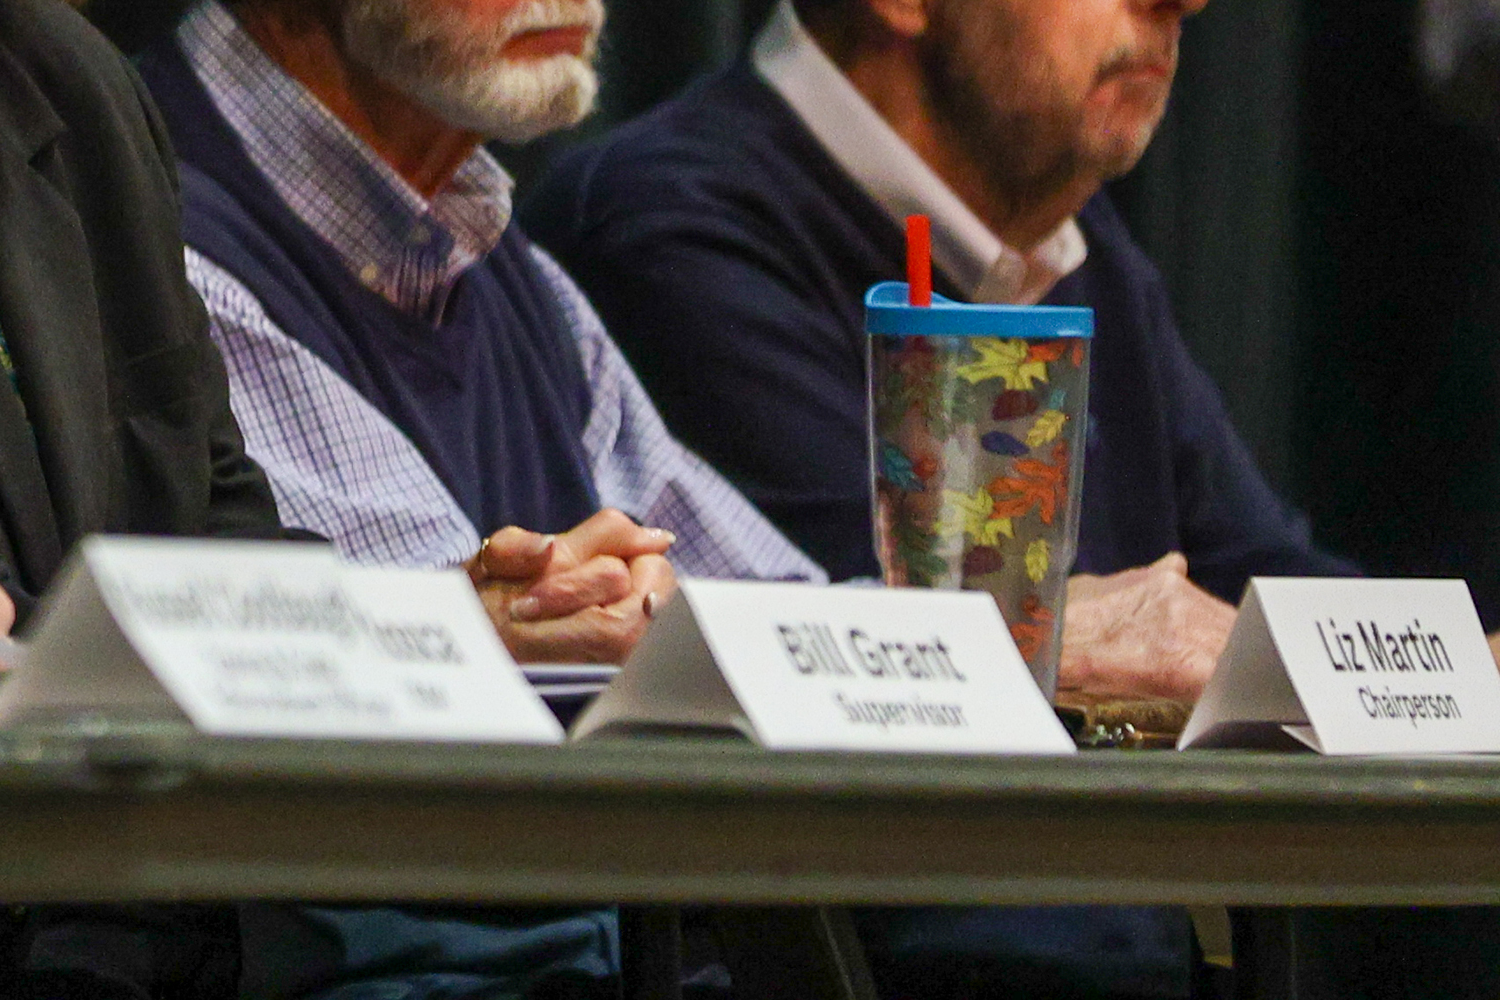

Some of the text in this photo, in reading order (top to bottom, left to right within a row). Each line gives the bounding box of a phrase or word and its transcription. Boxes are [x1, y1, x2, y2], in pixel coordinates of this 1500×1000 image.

[775, 623, 967, 682] Bill Grant
[1315, 618, 1454, 673] Liz Martin
[835, 690, 968, 731] Supervisor
[1358, 686, 1462, 729] Chairperson
